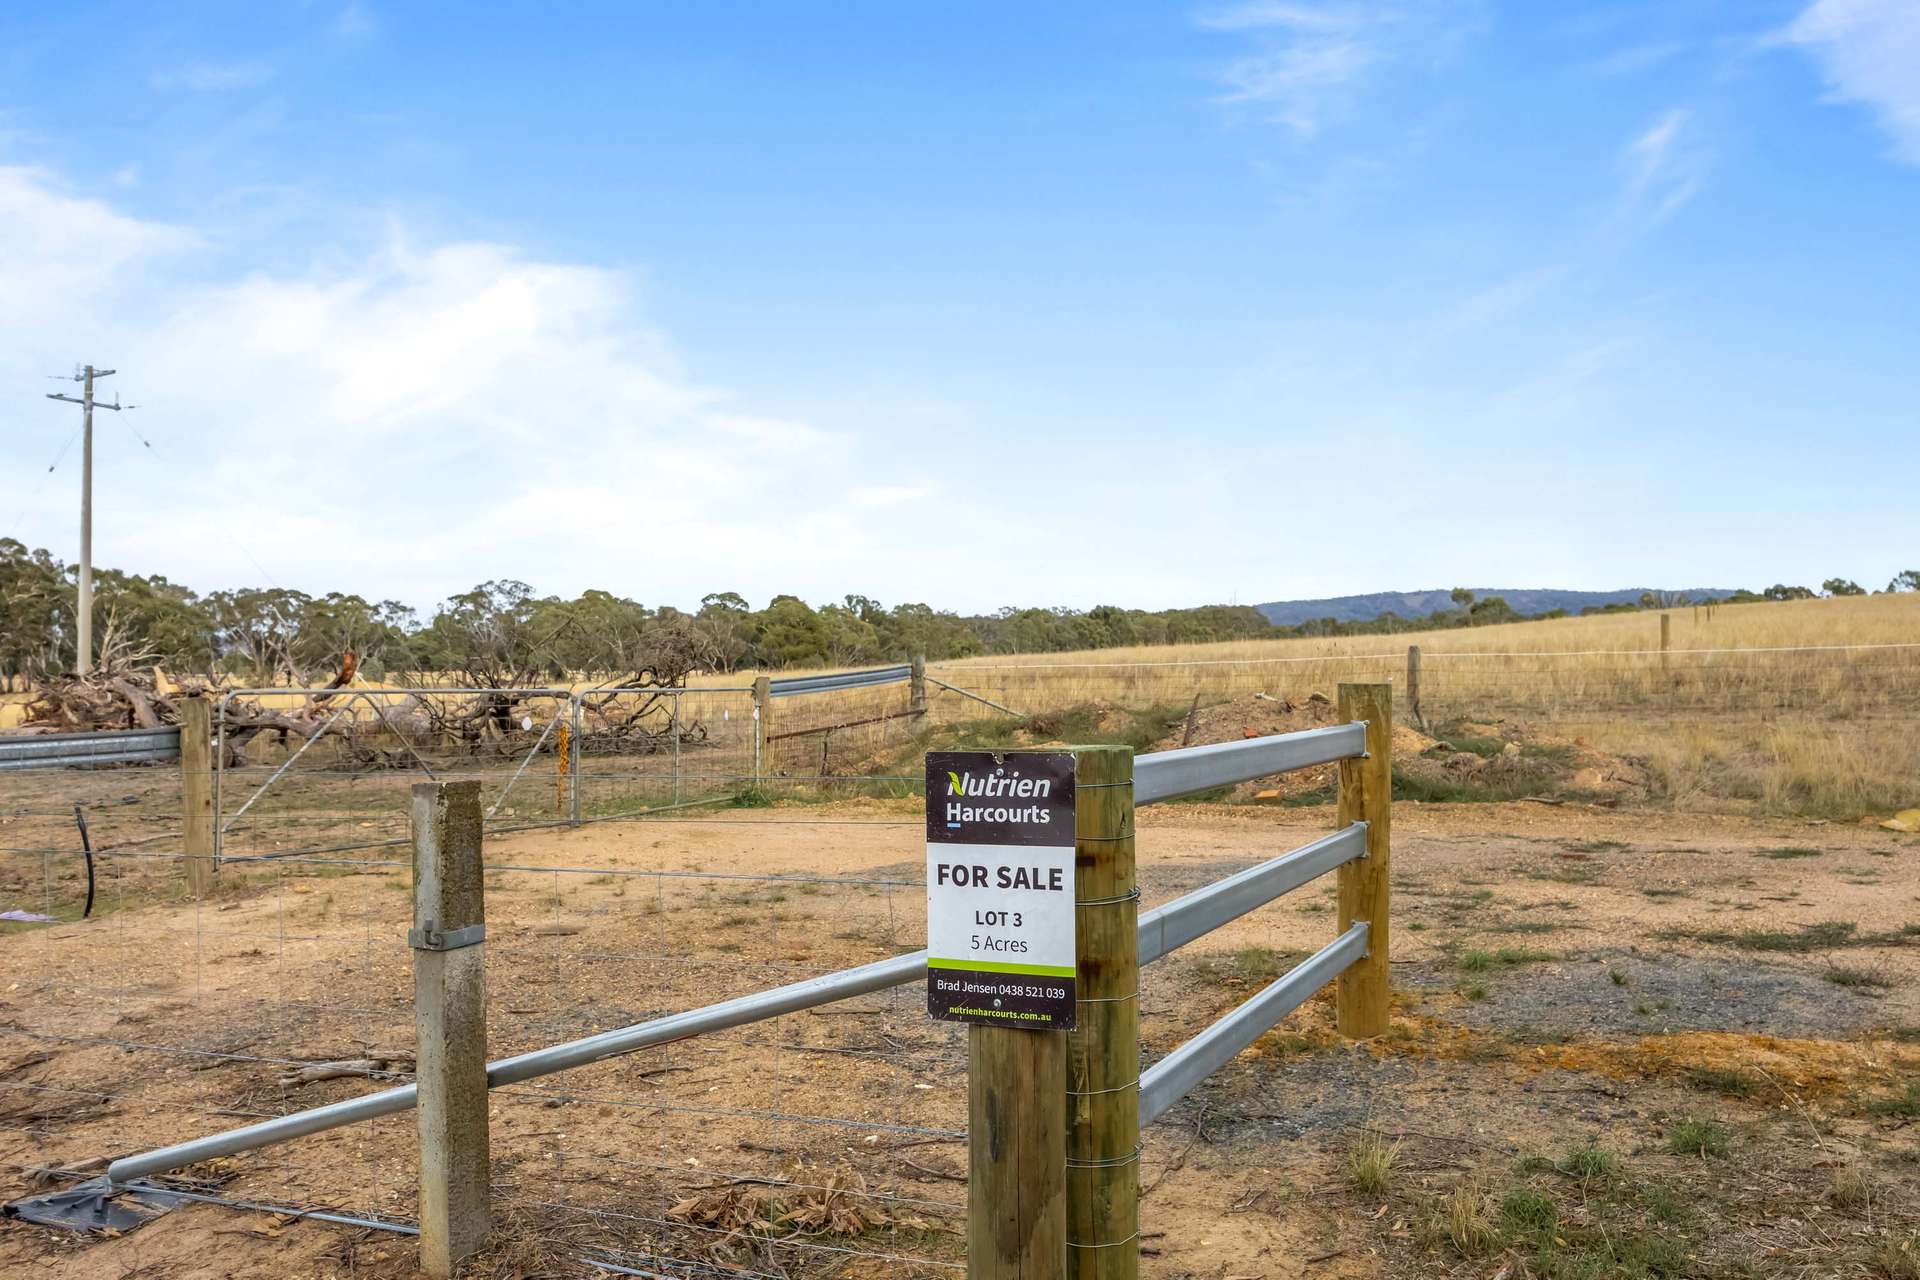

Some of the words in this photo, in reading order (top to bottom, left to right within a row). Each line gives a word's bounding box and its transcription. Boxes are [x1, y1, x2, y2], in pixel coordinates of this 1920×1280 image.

[946, 771, 1051, 797] Nutrien
[946, 803, 1051, 824] Harcourts
[937, 863, 989, 889] FOR
[996, 865, 1064, 891] SALE
[975, 910, 1009, 927] LOT
[1013, 912, 1023, 928] 3
[971, 934, 980, 950] 5
[983, 935, 1028, 953] Acres
[937, 979, 960, 993] Brad
[961, 981, 997, 994] Jensen
[998, 984, 1024, 997] 0438
[1025, 985, 1045, 998] 521
[1046, 987, 1065, 999] 039
[949, 1006, 1052, 1021] nutrienharcourts.com.au
